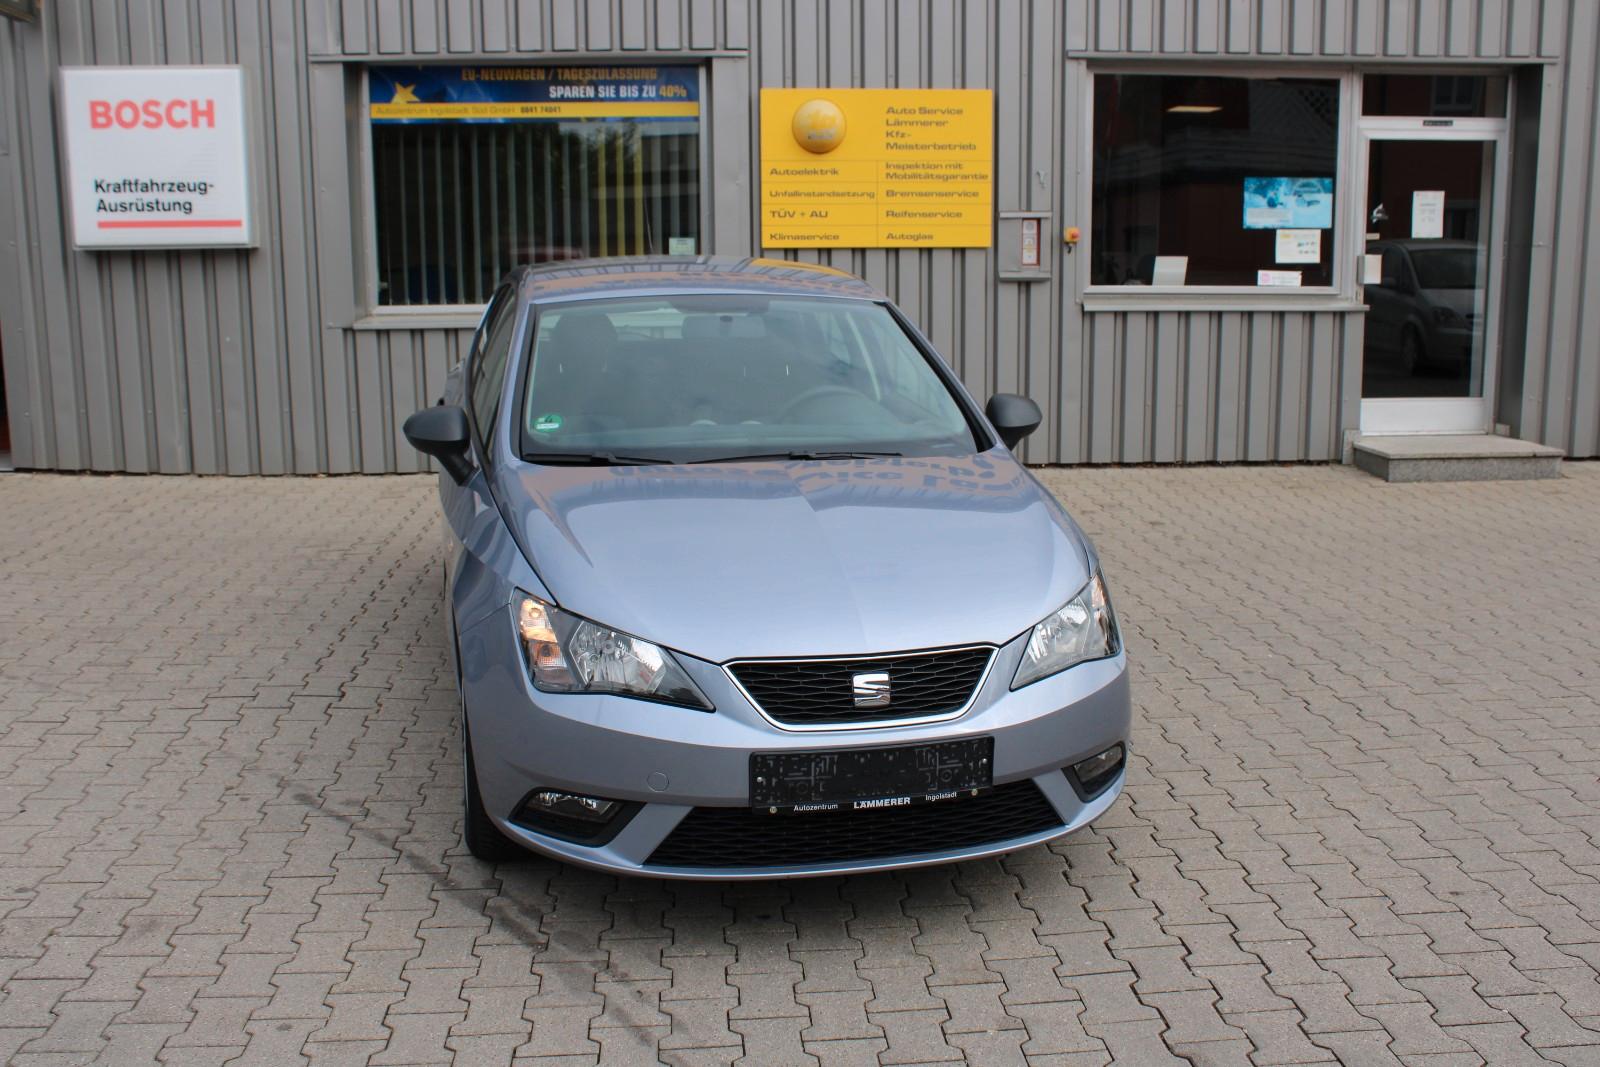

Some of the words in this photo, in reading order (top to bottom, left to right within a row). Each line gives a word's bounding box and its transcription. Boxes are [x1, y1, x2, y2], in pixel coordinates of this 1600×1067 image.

[461, 68, 545, 80] EU-NEUWAGEN
[557, 67, 658, 80] TAGESZULASSUNG
[549, 85, 595, 98] SPAREN
[598, 85, 616, 98] SIE
[619, 85, 639, 98] BIS
[642, 85, 656, 97] ZU
[659, 85, 687, 97] 40%
[90, 99, 215, 129] BOSCH
[886, 107, 916, 115] Auto
[918, 107, 964, 115] Service
[886, 118, 949, 127] Lämmerer
[886, 142, 977, 150] Meisterbetrieb
[886, 162, 943, 171] Inspektion
[945, 162, 963, 170] mit
[770, 168, 839, 176] Autoelektrik
[886, 172, 989, 182] Mobilitätsgarantie
[94, 179, 214, 195] Kraftfahrzeug-
[769, 190, 876, 199] Unfallinstandsetzung
[886, 190, 979, 198] Bremsenservice
[96, 198, 193, 214] Ausrüstung
[770, 208, 796, 218] TÜV
[810, 210, 829, 218] AU
[886, 210, 963, 218] Reifenservice
[770, 233, 840, 241] Klimaservice
[886, 233, 934, 242] Autoglas
[926, 791, 957, 802] Ingolstadt
[794, 803, 838, 812] Autozentrum
[853, 797, 911, 809] LÄMMERER
